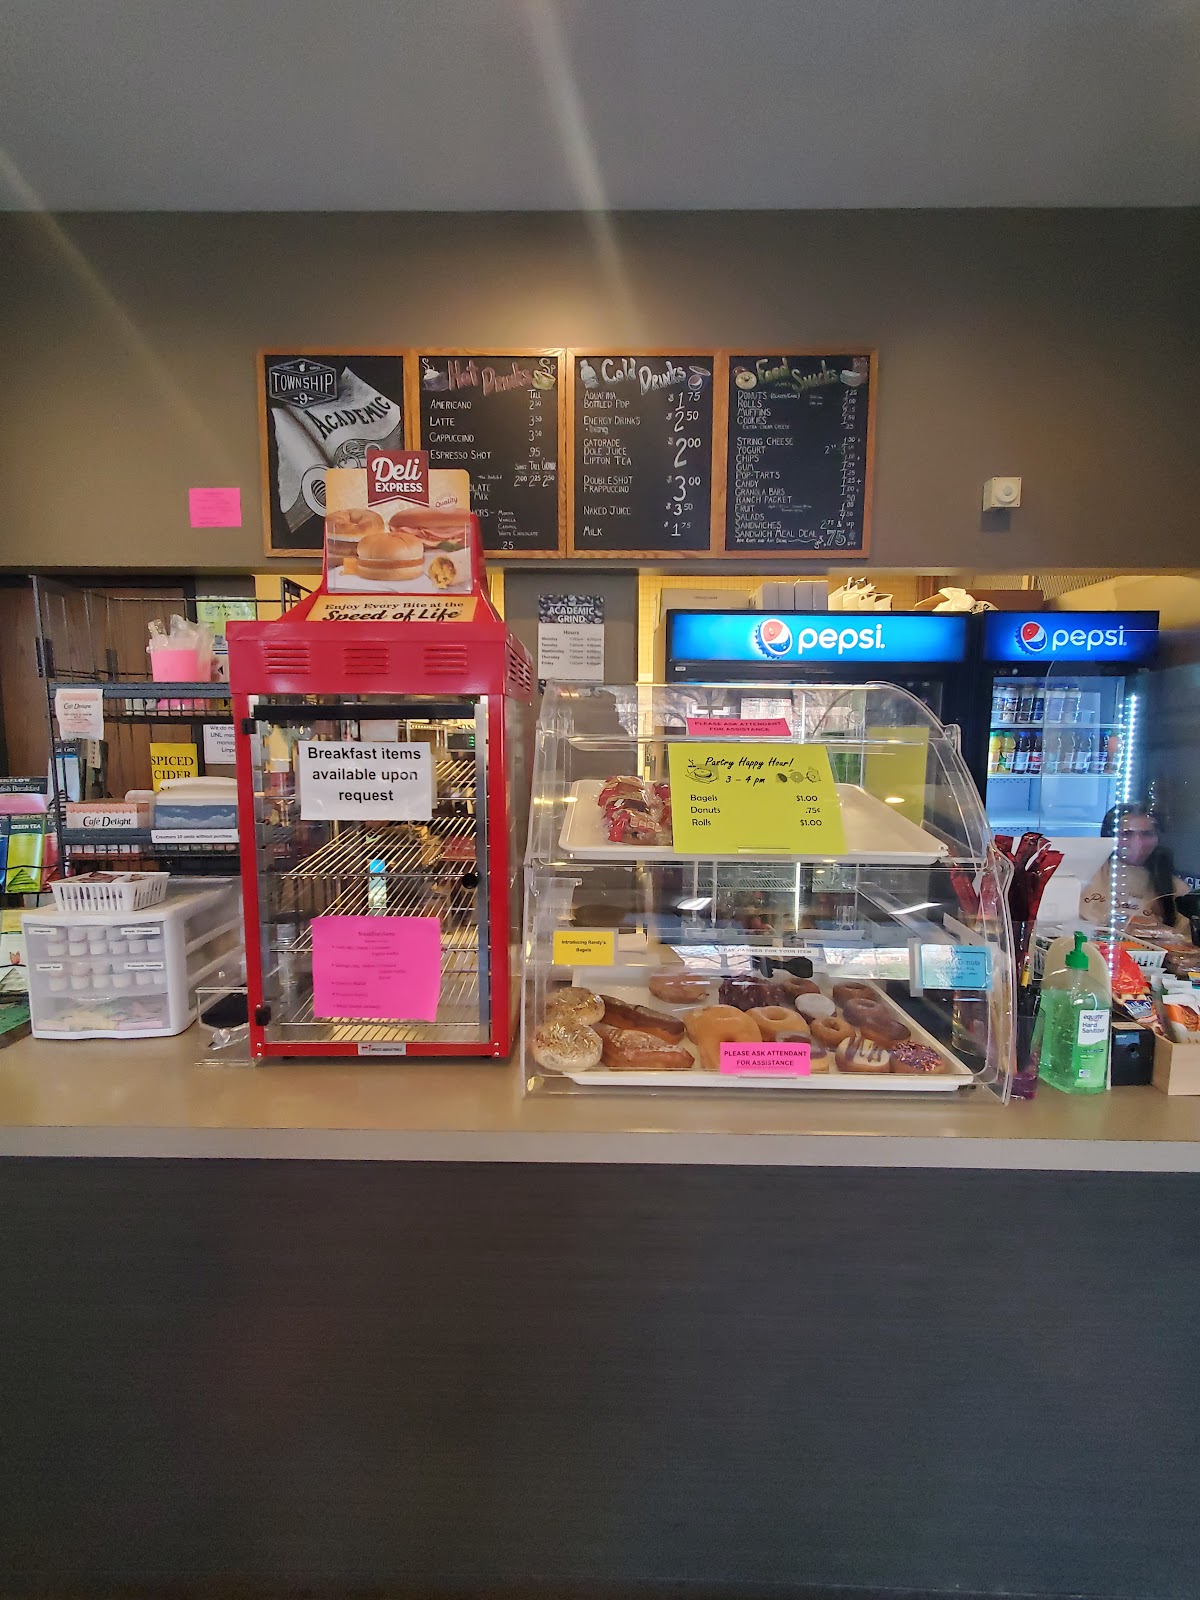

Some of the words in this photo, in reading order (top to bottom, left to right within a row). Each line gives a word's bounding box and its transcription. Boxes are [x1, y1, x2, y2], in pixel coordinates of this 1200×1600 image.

[448, 360, 478, 390] Hot
[601, 358, 636, 384] Cold
[272, 372, 334, 393] TOWNSHIP
[299, 392, 308, 404] 9
[585, 390, 616, 400] AQUAFINA
[738, 390, 768, 400] DONUTS
[430, 399, 472, 410] AMERICANO
[584, 400, 612, 408] BOTTLED
[616, 400, 630, 408] POP
[738, 400, 762, 408] ROLLS
[737, 408, 771, 416] MUFFINS
[303, 396, 391, 440] ACADEMIC
[430, 416, 455, 426] LATTE
[584, 416, 612, 425] ENERGY
[614, 416, 640, 425] DRINKS
[737, 416, 767, 425] COOKIES
[429, 432, 474, 442] CAPPUCCINO
[737, 437, 763, 446] STRING
[766, 436, 794, 446] CHEESE
[584, 438, 620, 447] GATORADE
[430, 450, 468, 460] ESPRESSO
[471, 450, 492, 460] SHOT
[584, 447, 602, 456] DOLE
[606, 447, 627, 456] JUICE
[738, 446, 766, 454] YOGURT
[584, 456, 611, 464] LIPTON
[614, 456, 632, 466] TEA
[736, 454, 760, 462] CHIPS
[372, 457, 422, 482] Deli
[736, 463, 754, 471] GUM
[584, 475, 633, 485] DOUBLESHOT
[736, 471, 780, 480] POP-TARTS
[375, 482, 423, 492] EXPRESS
[584, 485, 630, 493] FRAPPUCCINO
[736, 480, 758, 488] CANDY
[474, 491, 488, 500] MIX
[736, 488, 766, 496] GRANOLA
[768, 488, 786, 496] BARS
[435, 496, 458, 508] Quality
[736, 496, 762, 504] RANCH
[764, 496, 792, 504] PACKET
[584, 506, 607, 515] NAKED
[610, 506, 630, 515] JUICE
[735, 504, 754, 512] FRUIT
[735, 512, 764, 520] SALADS
[735, 520, 782, 530] SANDWICHES
[584, 526, 602, 536] MILK
[735, 530, 772, 538] SANDWICH
[775, 528, 795, 538] MEAL
[798, 528, 817, 538] DEAL
[322, 610, 388, 621] Speed
[392, 609, 416, 622] of
[418, 608, 462, 622] Life
[549, 606, 594, 614] ACADEMIC
[558, 615, 586, 623] GRIND
[798, 624, 883, 654] pepsi
[1052, 625, 1126, 651] pepsi
[308, 747, 377, 759] Breakfast
[382, 748, 421, 759] items
[151, 756, 194, 766] SPICED
[705, 757, 734, 769] Pastry
[738, 757, 764, 770] Happy
[768, 758, 794, 768] Hour!
[312, 768, 376, 780] available
[382, 771, 418, 783] upon
[753, 778, 765, 786] pm
[339, 790, 394, 803] request
[83, 816, 100, 826] Café
[102, 816, 131, 828] Delight
